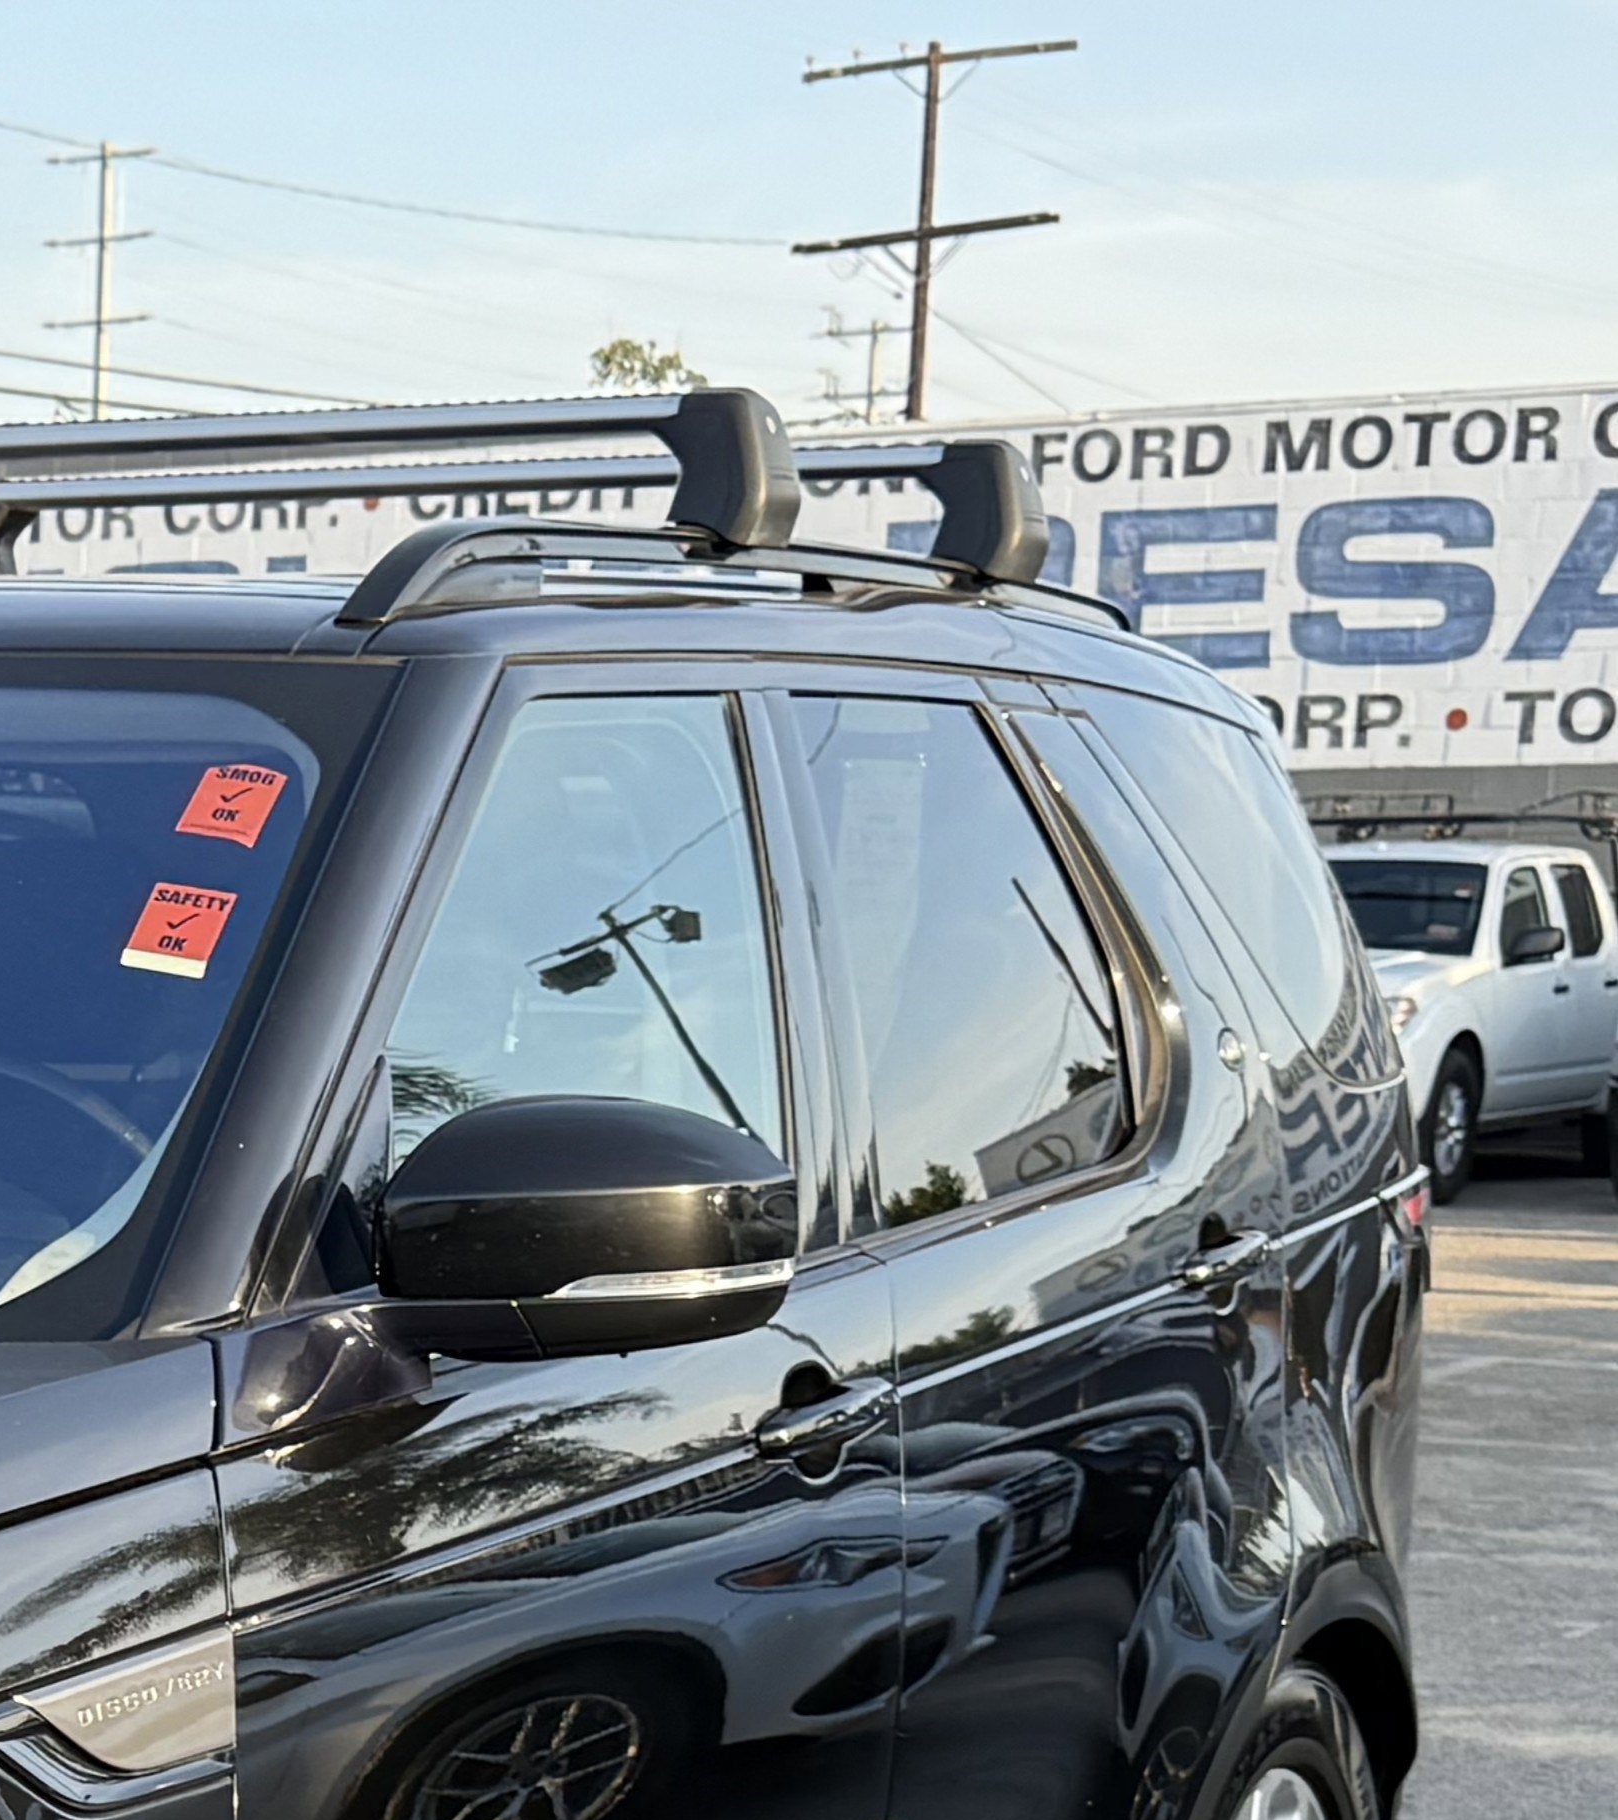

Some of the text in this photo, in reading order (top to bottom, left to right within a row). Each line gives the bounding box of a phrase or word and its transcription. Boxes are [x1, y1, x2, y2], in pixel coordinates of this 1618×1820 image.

[1031, 423, 1232, 486] FORD
[1261, 406, 1561, 474] MOTOR
[215, 766, 278, 787] SMOG
[211, 807, 240, 822] OK
[153, 888, 230, 912] SAFETY
[158, 935, 188, 952] OK
